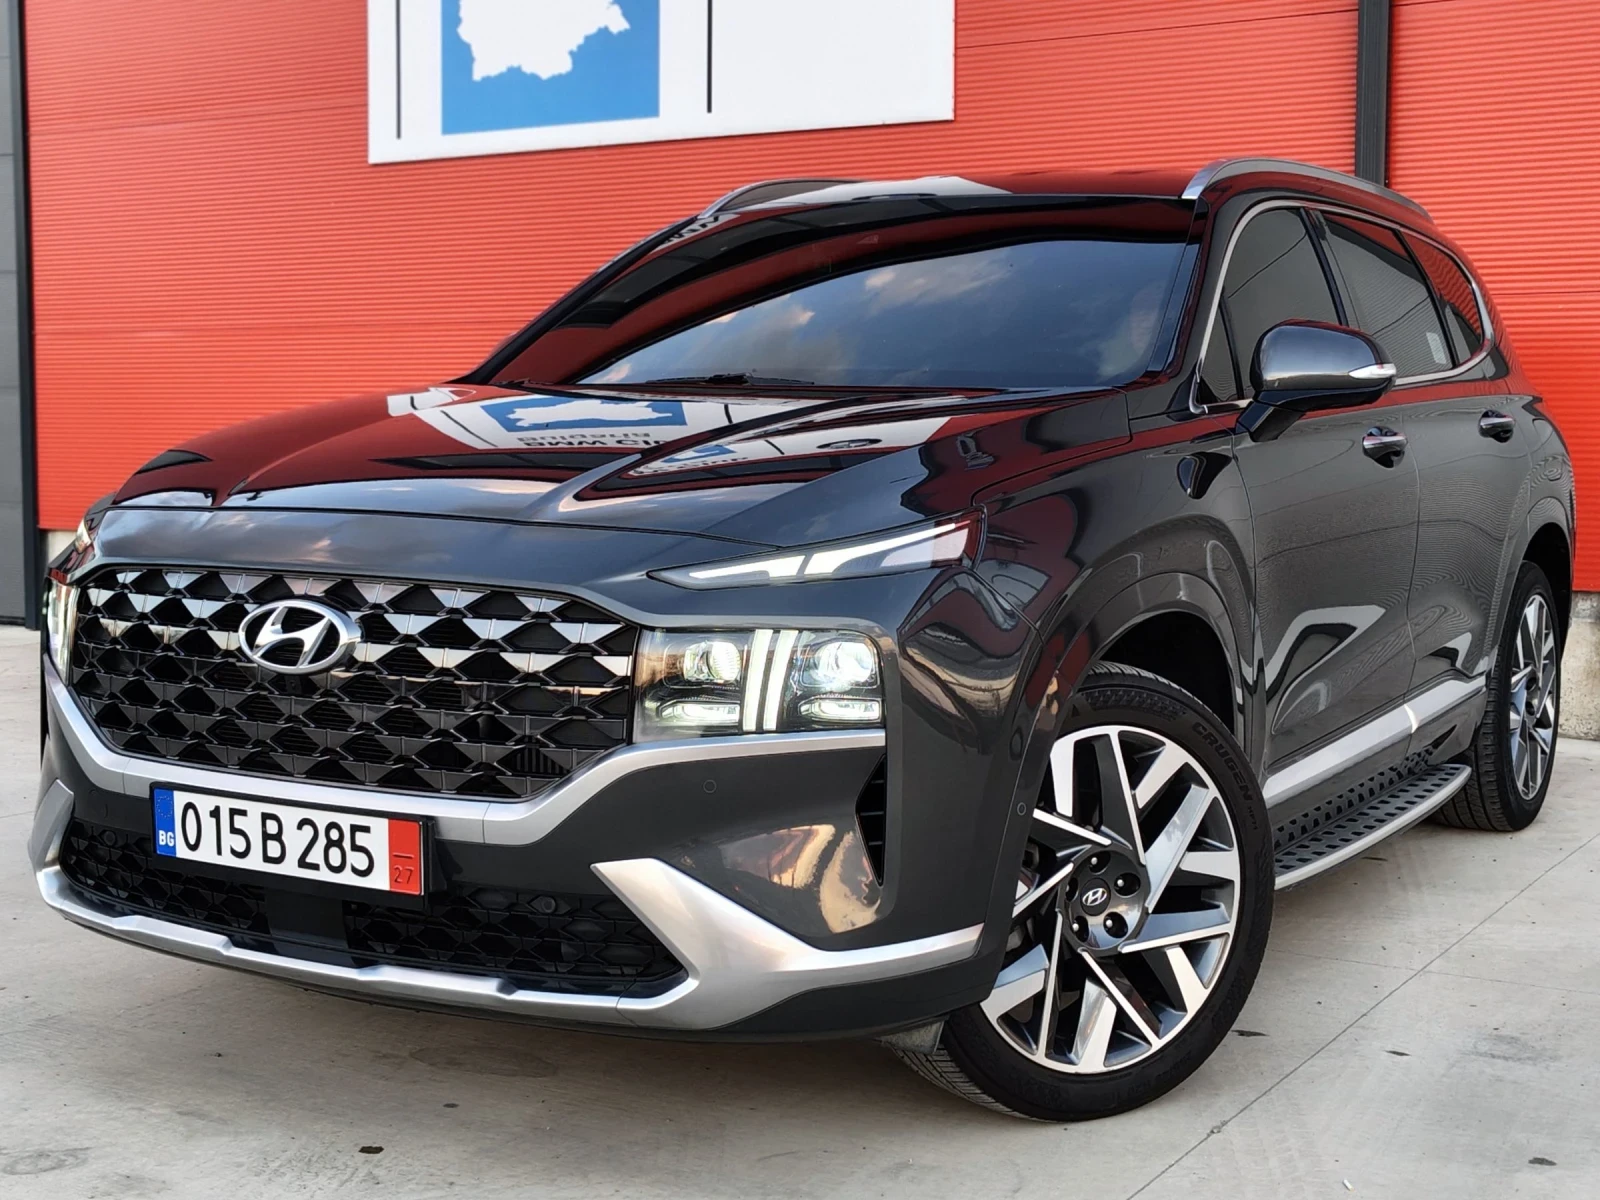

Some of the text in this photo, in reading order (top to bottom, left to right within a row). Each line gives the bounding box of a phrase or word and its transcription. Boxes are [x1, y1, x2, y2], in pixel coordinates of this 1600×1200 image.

[1192, 721, 1252, 800] CRUGEN
[158, 829, 175, 847] BG
[393, 864, 415, 885] 27
